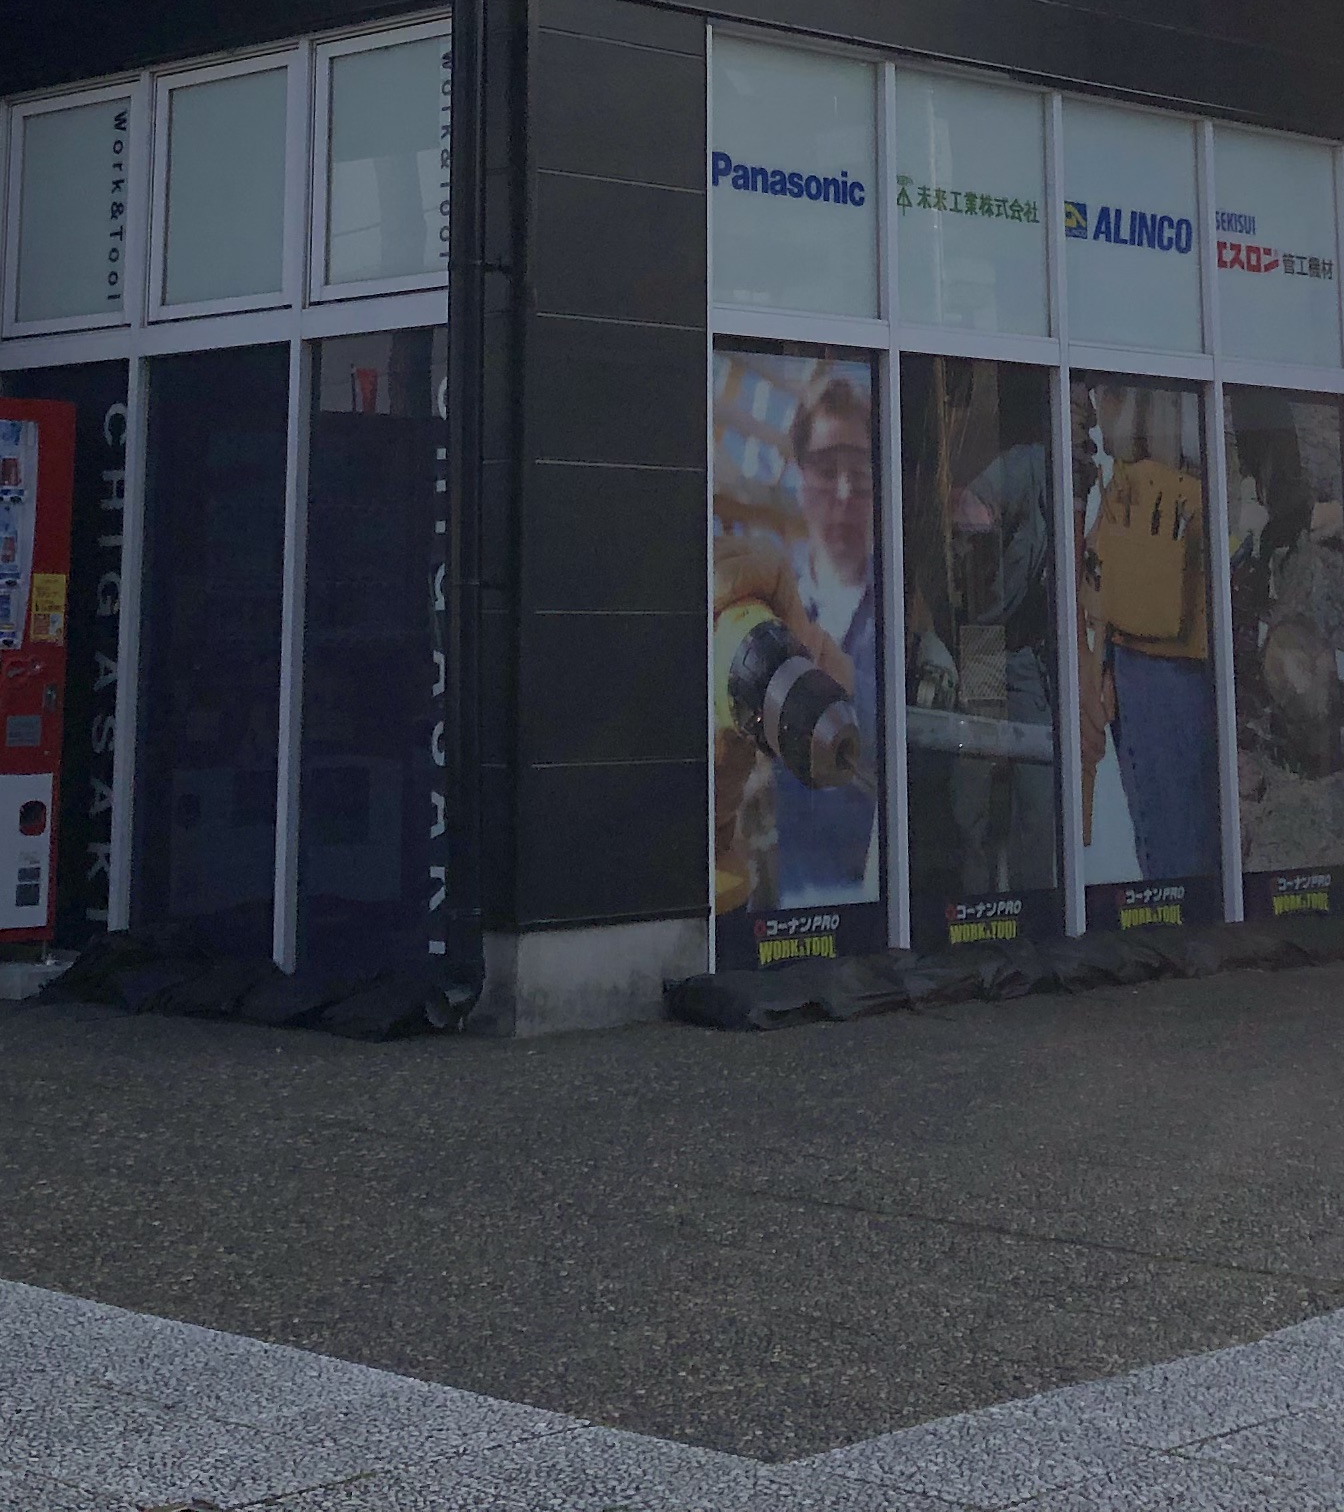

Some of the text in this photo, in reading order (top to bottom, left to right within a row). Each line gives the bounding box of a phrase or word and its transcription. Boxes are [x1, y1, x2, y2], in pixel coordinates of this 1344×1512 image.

[711, 151, 865, 208] Panasonic
[107, 109, 128, 302] Work&Tool
[916, 185, 1040, 224] 未来工業株式会社
[1092, 206, 1193, 254] ALINCO
[766, 913, 840, 936] コーナンPRO
